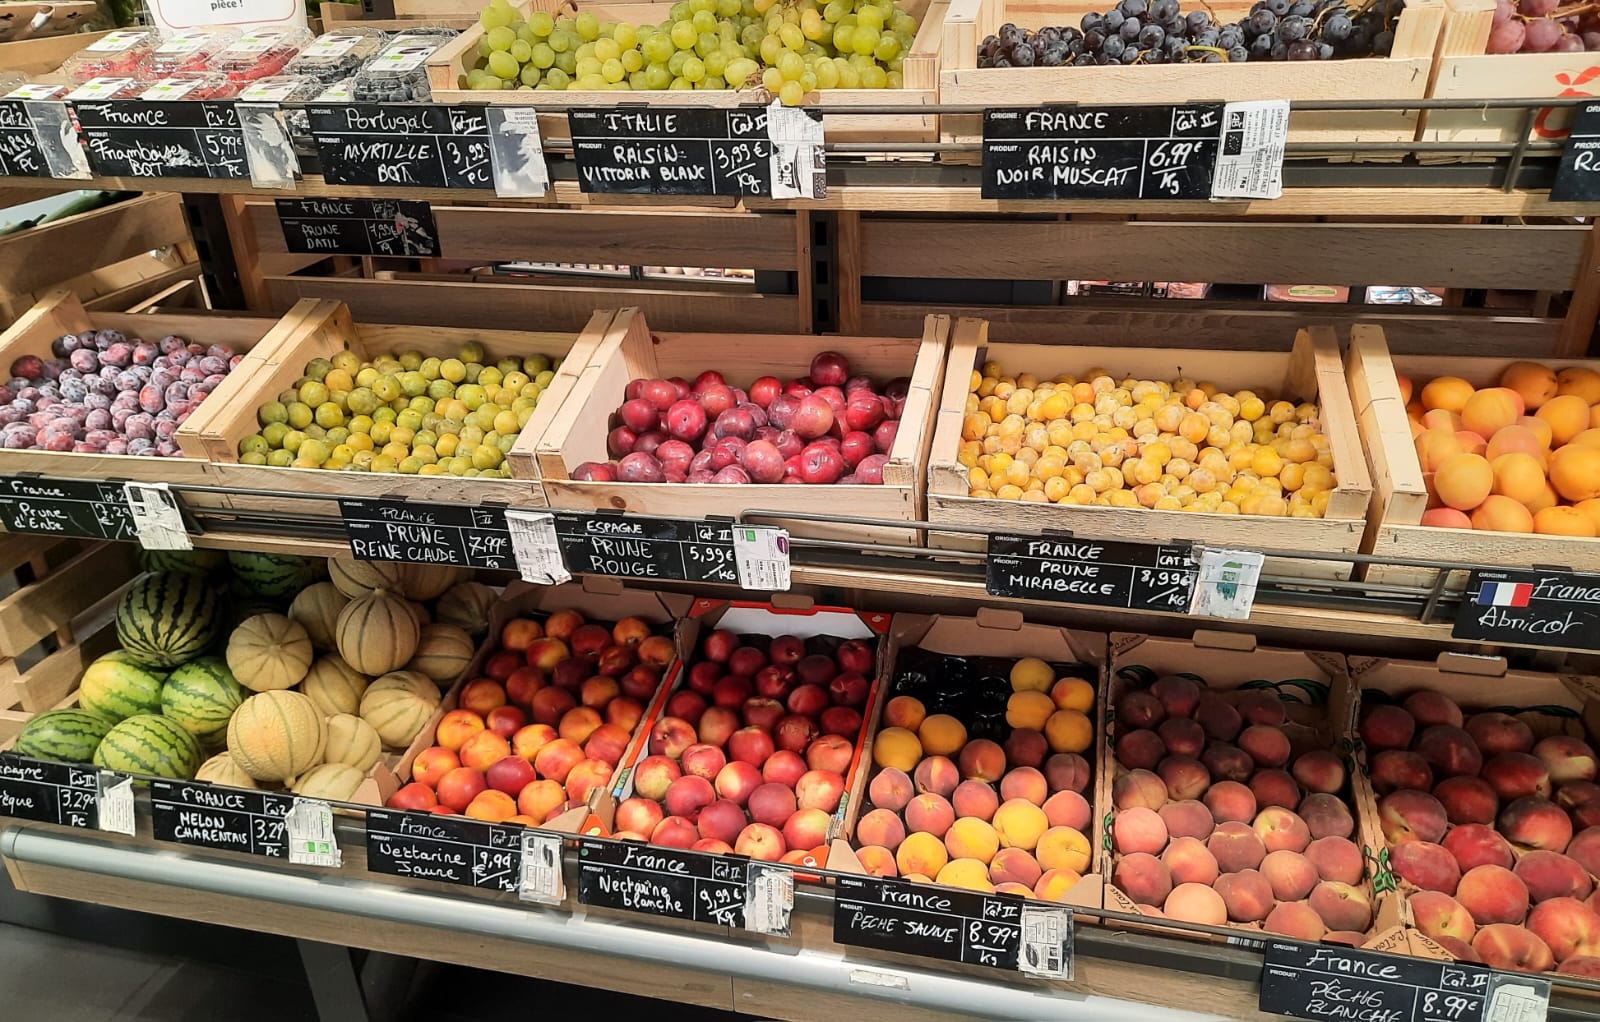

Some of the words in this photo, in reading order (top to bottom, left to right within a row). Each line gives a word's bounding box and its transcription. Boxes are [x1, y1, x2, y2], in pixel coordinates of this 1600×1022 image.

[97, 103, 168, 125] France
[226, 109, 238, 127] 2
[346, 107, 433, 131] Portugal
[604, 112, 677, 133] ITALIE
[1025, 111, 1109, 131] FRANCE
[344, 141, 431, 161] MYRTILLE
[582, 166, 652, 183] VITTORIA
[660, 164, 707, 182] BLANC
[997, 168, 1044, 186] NOIR
[1053, 164, 1138, 187] MUSCAT
[301, 200, 354, 216] FRANCE
[302, 224, 341, 238] PRUNE
[19, 502, 68, 520] Prune
[379, 507, 436, 525] FRANCE
[386, 523, 450, 547] PRUNE
[586, 520, 643, 535] ESPAGNE
[717, 528, 733, 541] II
[352, 538, 403, 560] REINE
[407, 546, 459, 563] CLAUDE
[592, 536, 653, 559] PRUNE
[690, 546, 735, 565] 5,99€
[1028, 541, 1105, 560] FRANCE
[590, 555, 660, 577] ROUGE
[1040, 561, 1100, 578] PRUNE
[1159, 556, 1181, 567] CAT
[1009, 574, 1116, 596] MIRABELLE
[1478, 606, 1586, 635] Abricot
[181, 787, 246, 809] FRANCE
[179, 811, 225, 830] MELON
[174, 825, 249, 847] CHARENTAIS
[623, 847, 690, 874] France
[623, 892, 684, 914] blanche
[881, 885, 952, 912] France
[851, 911, 899, 933] PECHE
[1001, 906, 1018, 918] II
[1305, 949, 1403, 980] France
[1309, 977, 1384, 1008] PÊCHE
